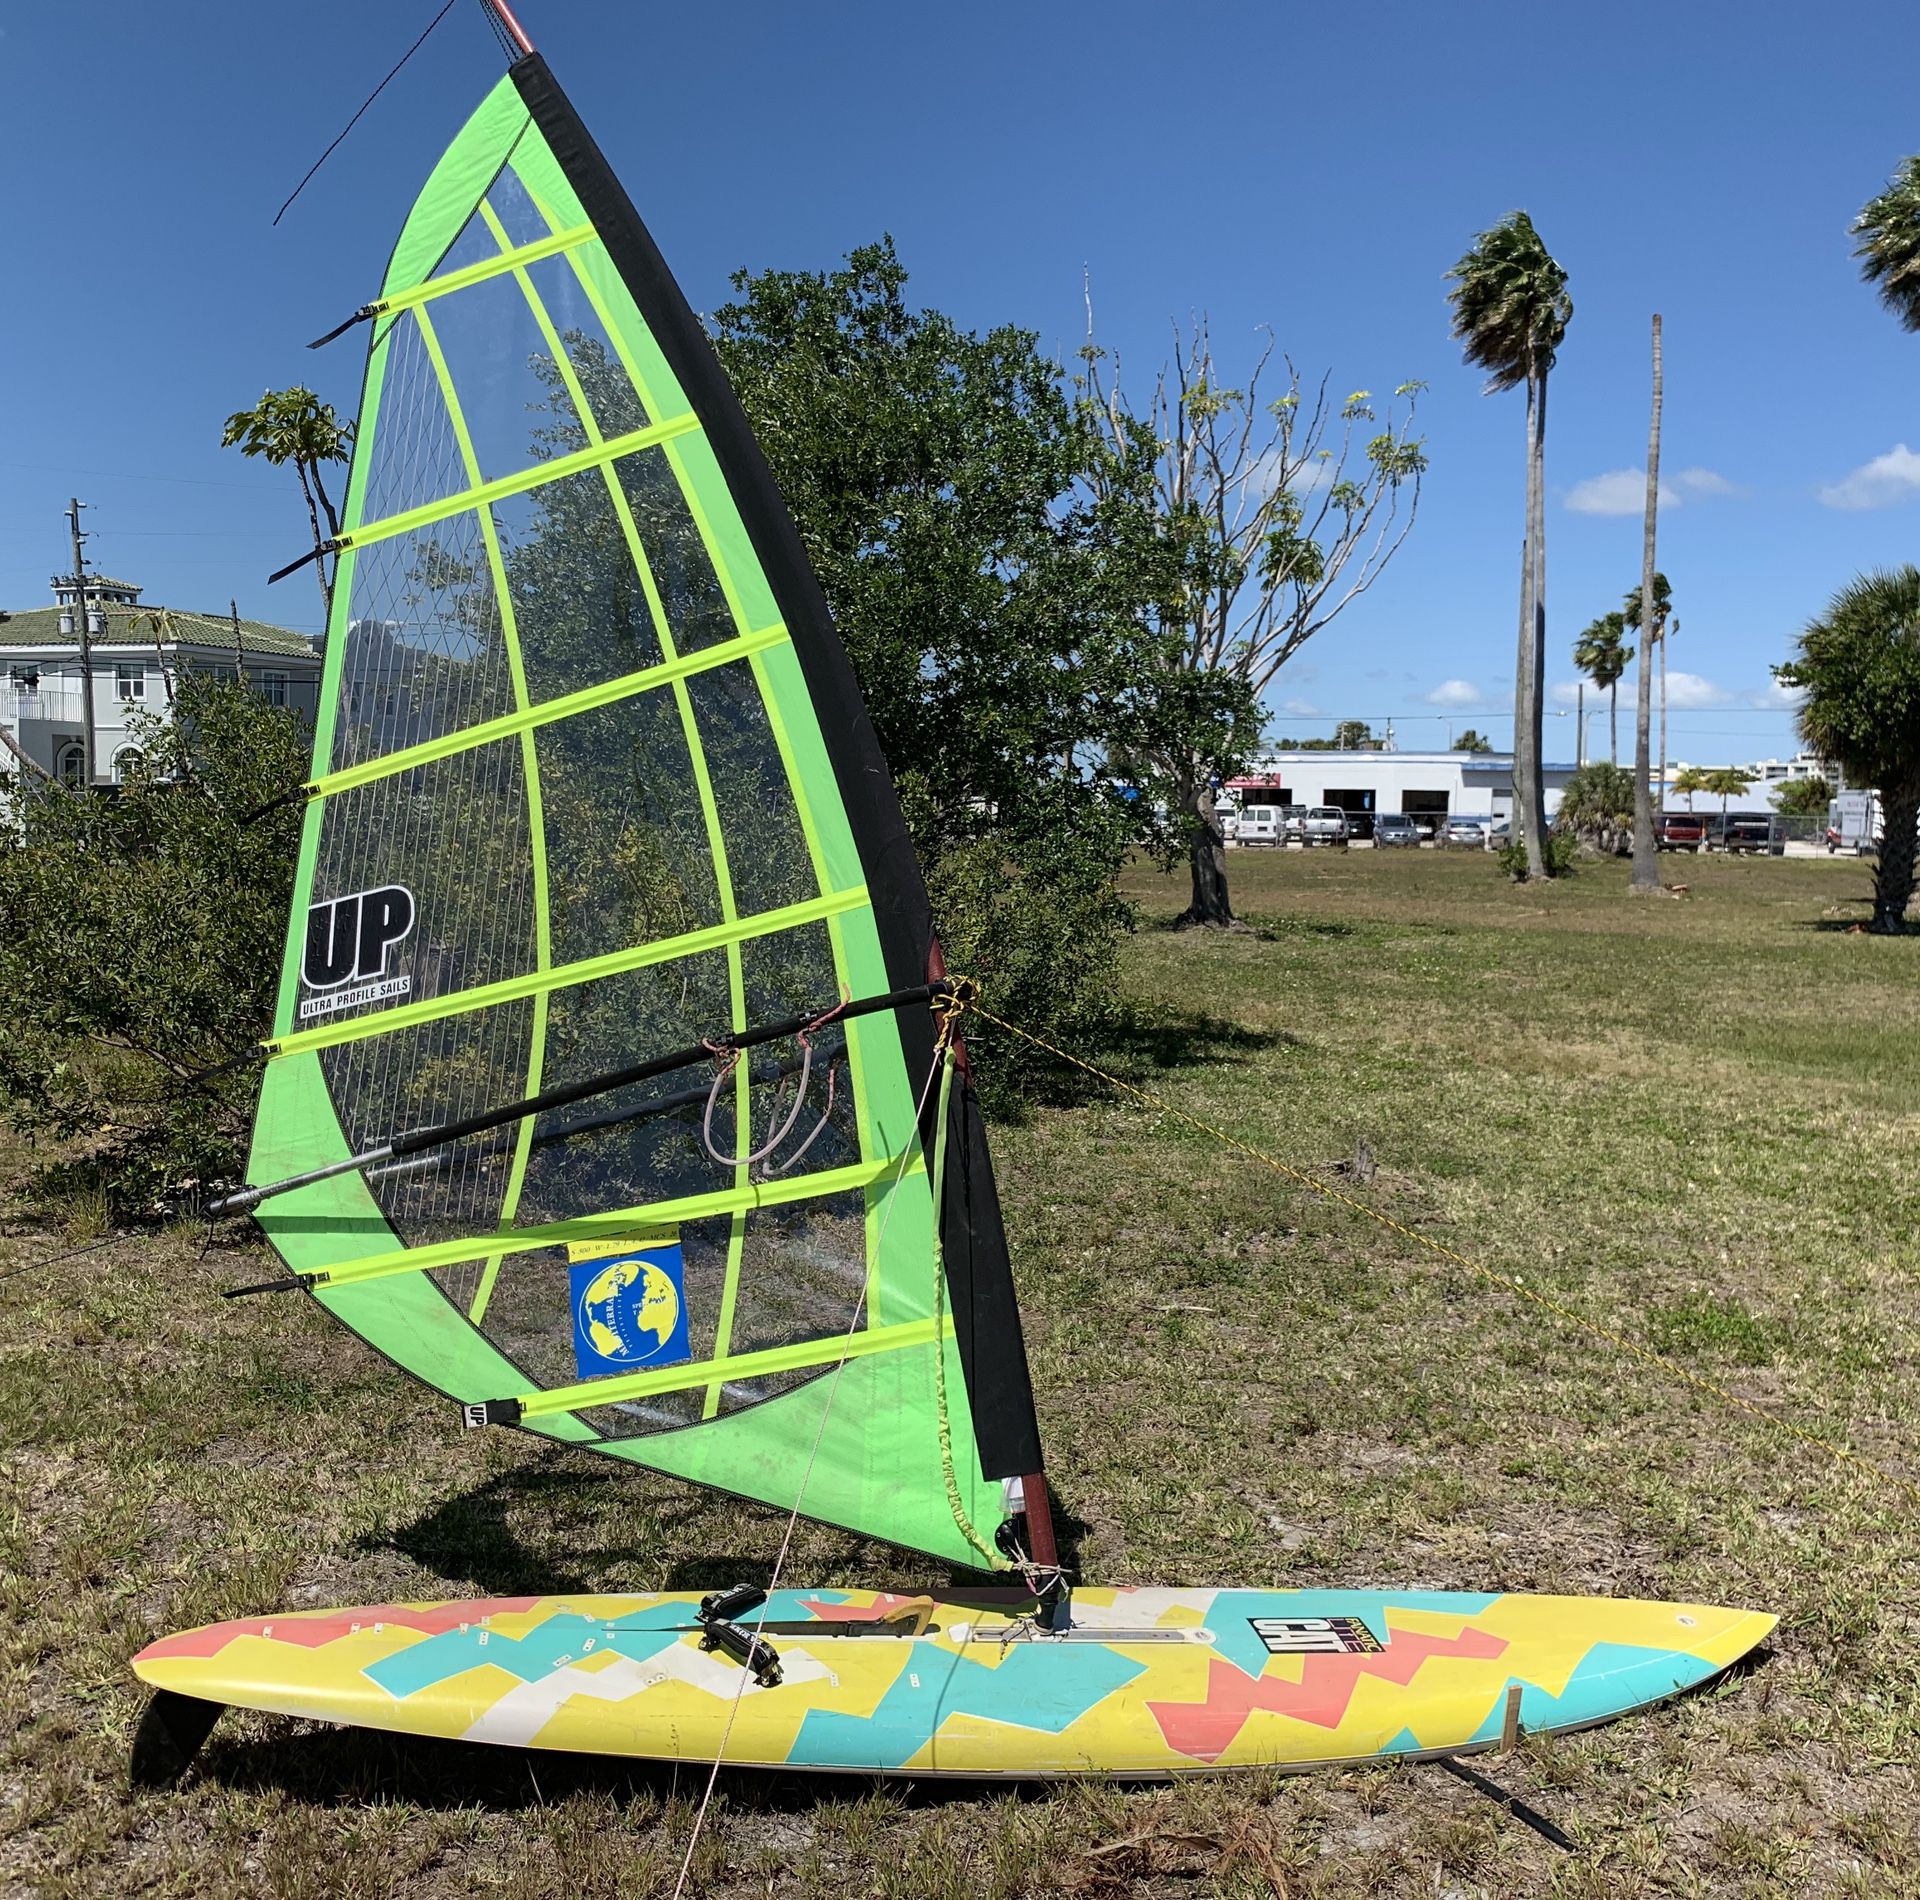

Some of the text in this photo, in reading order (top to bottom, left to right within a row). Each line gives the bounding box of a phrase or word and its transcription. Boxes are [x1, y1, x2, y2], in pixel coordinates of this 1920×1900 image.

[301, 885, 415, 990] UP
[303, 979, 408, 1015] ULTRA PROFILE SAILS
[470, 1406, 485, 1425] UP
[1252, 1618, 1349, 1653] CAT
[1345, 1617, 1383, 1653] FANATIC
